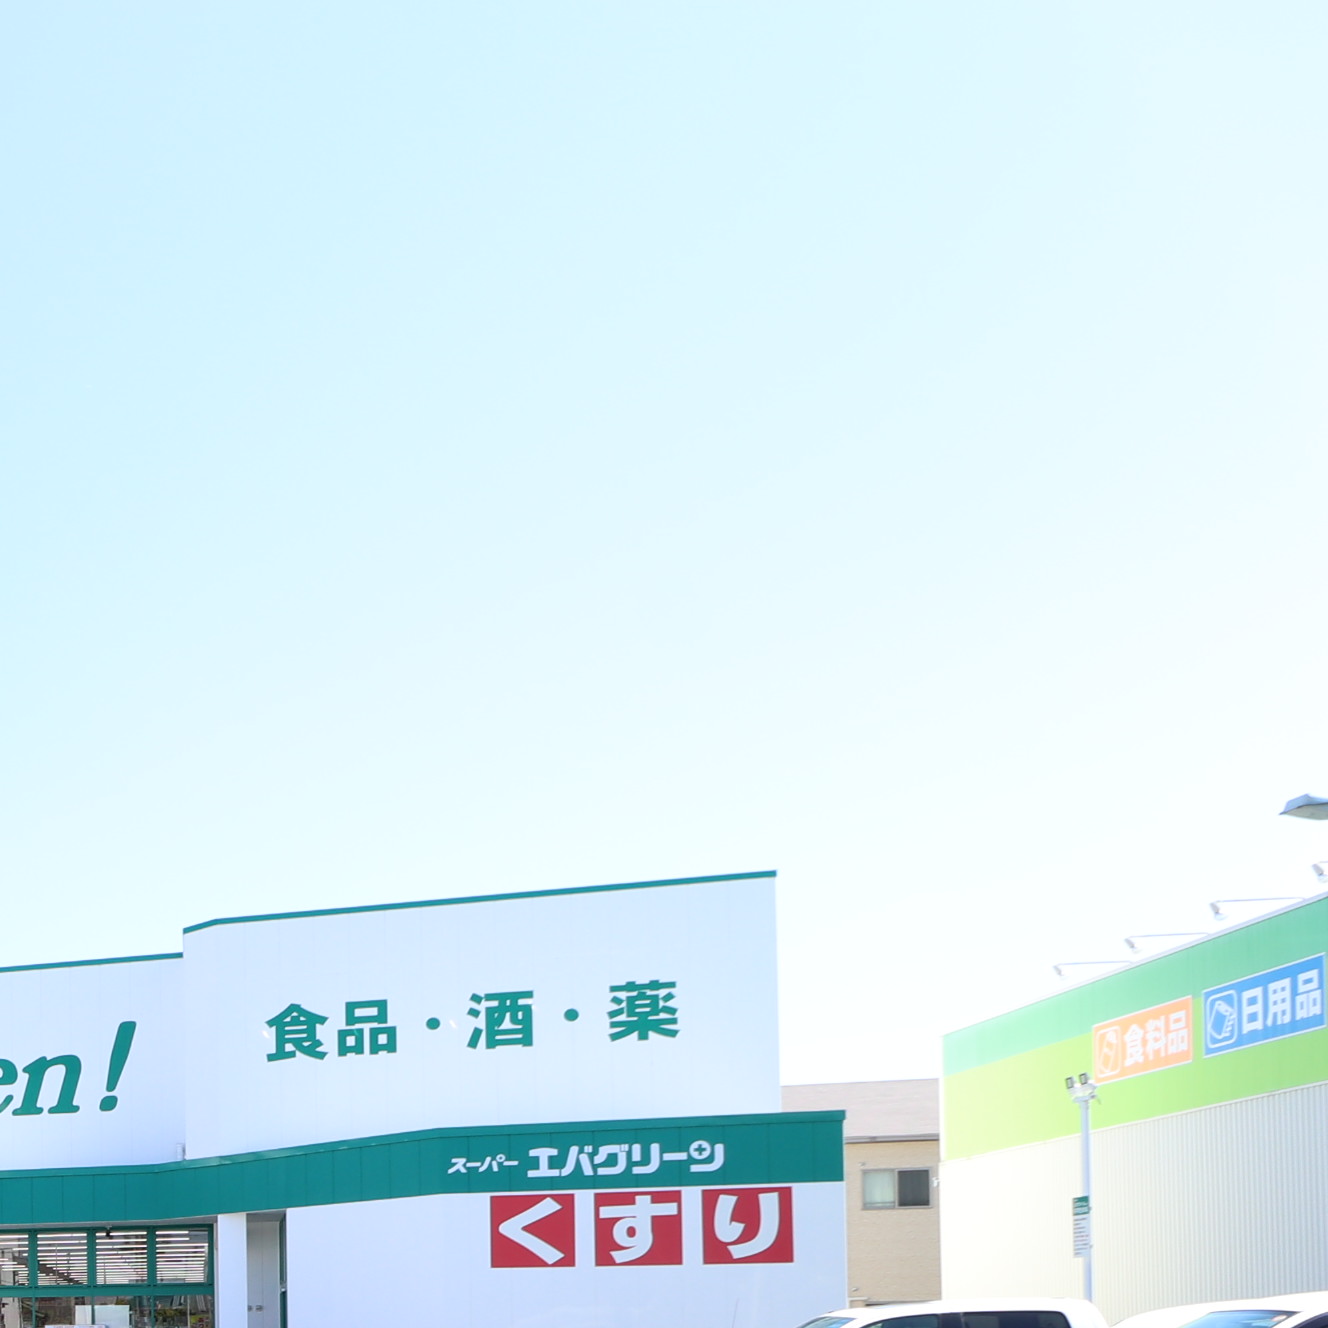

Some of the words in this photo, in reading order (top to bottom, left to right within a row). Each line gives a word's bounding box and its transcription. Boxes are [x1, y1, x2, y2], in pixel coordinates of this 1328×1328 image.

[265, 979, 680, 1062] 食品・酒・薬
[1241, 968, 1323, 1034] 日用品
[1123, 1009, 1189, 1067] 食料品
[448, 1153, 519, 1175] スーパー
[527, 1140, 725, 1178] エバグリーン
[498, 1191, 780, 1265] くすり
